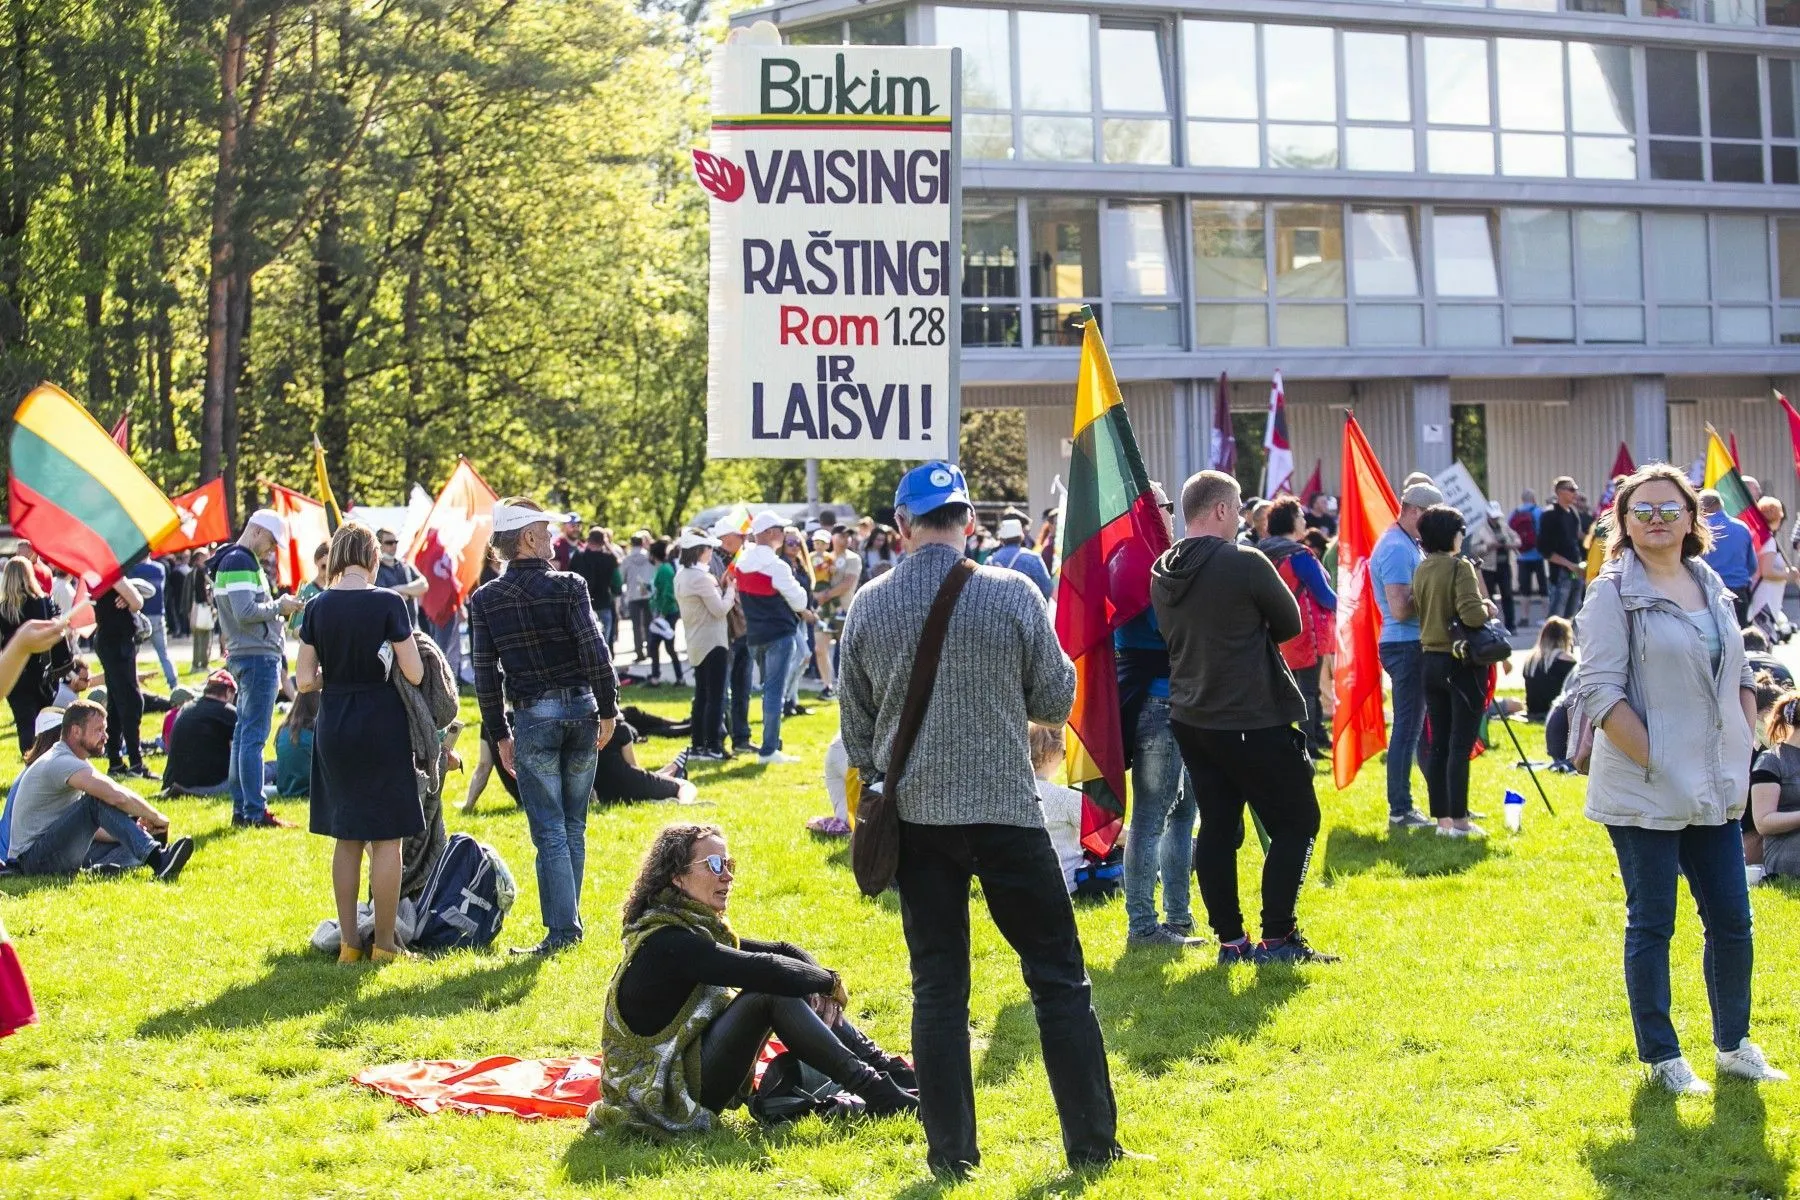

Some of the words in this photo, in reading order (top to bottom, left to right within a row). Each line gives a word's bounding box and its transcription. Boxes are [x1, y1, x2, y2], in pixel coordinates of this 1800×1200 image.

[761, 53, 940, 115] Būkim
[745, 149, 950, 205] VAISINGI
[743, 230, 950, 297] RAŠTINGI
[780, 305, 879, 346] Rom
[884, 306, 945, 346] 1.28
[816, 355, 855, 382] IR
